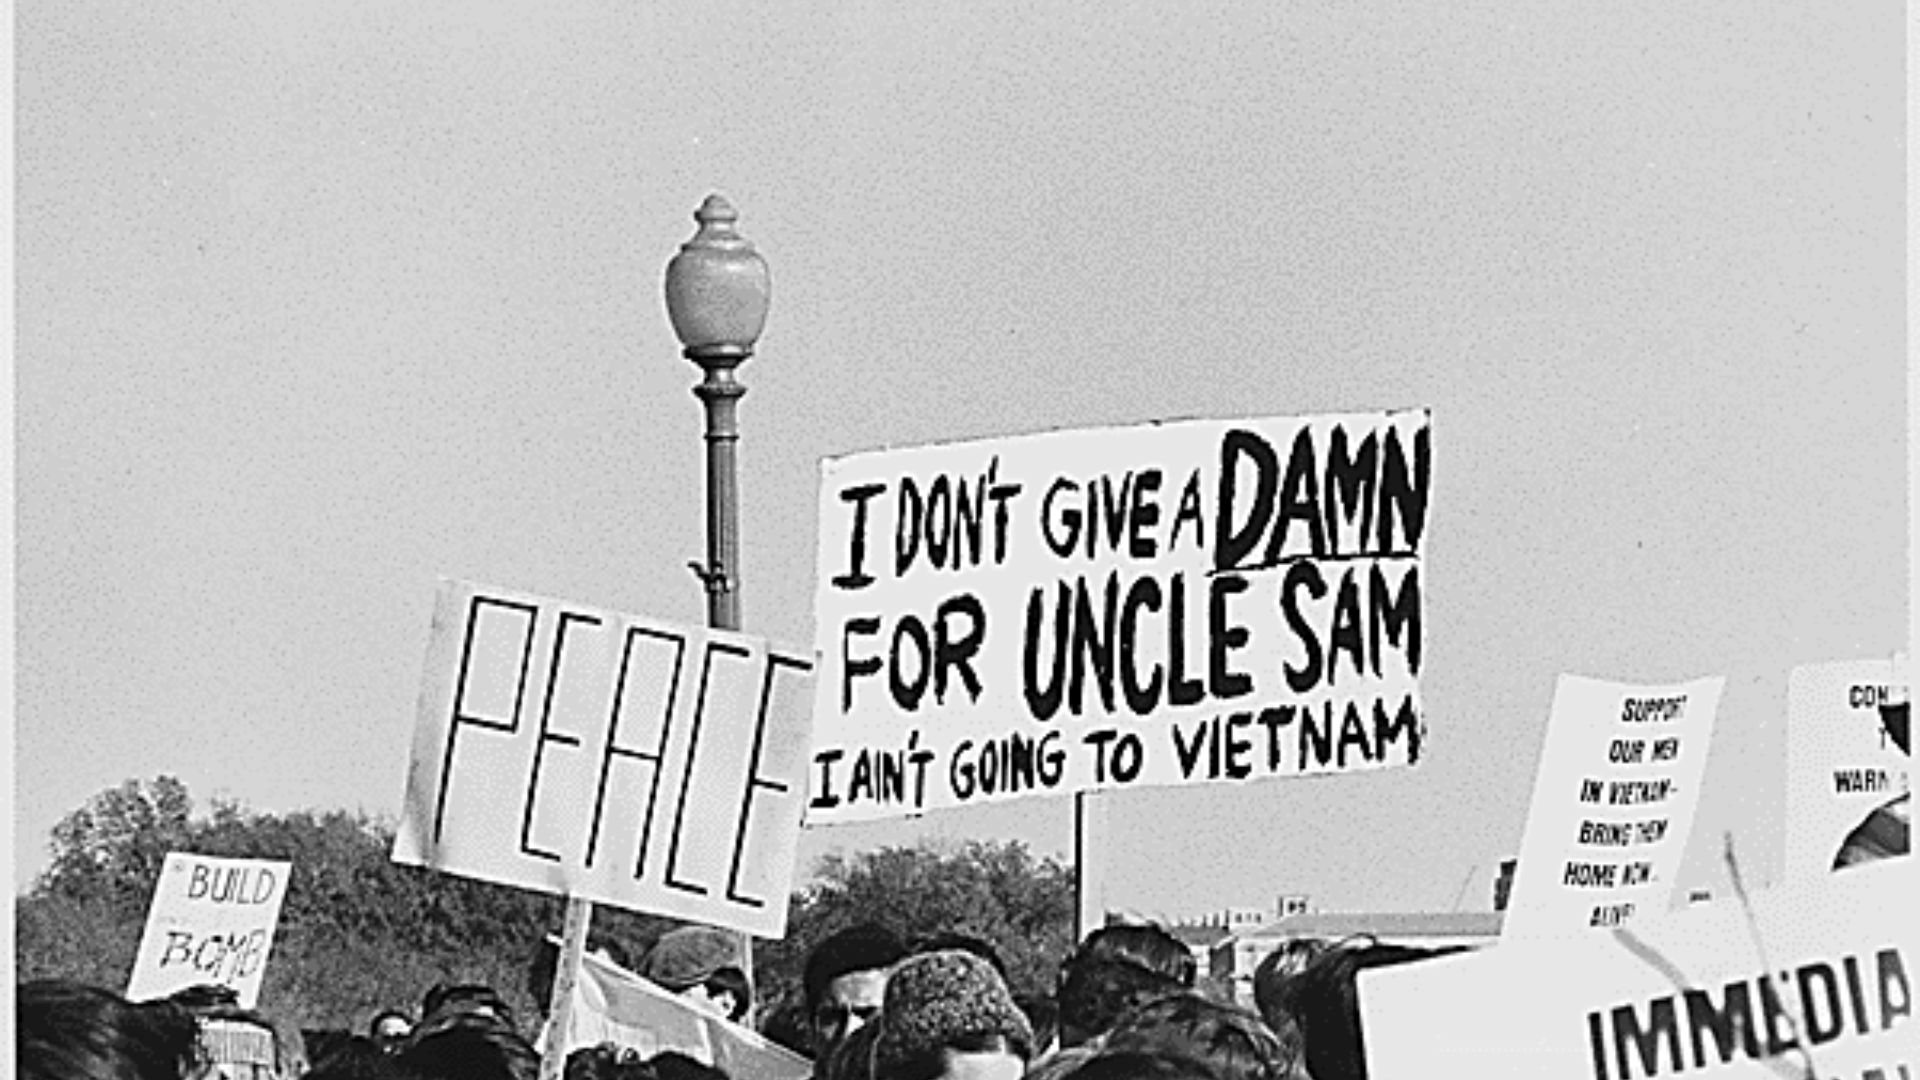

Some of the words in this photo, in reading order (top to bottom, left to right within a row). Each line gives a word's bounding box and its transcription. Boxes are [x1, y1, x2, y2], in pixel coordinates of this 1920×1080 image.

[832, 484, 886, 589] I
[896, 455, 1022, 576] DON'T
[1041, 470, 1162, 558] GIVE
[1170, 467, 1204, 551] A
[1215, 425, 1430, 570] DAMN
[843, 593, 986, 714] FOR
[1024, 570, 1253, 721] UNCLE
[1282, 560, 1422, 692] SAM
[434, 596, 813, 907] PEACE
[810, 750, 843, 807] I
[849, 729, 934, 807] AIN'T
[950, 731, 1066, 800] GOING
[1084, 731, 1143, 783] TO
[1173, 694, 1424, 781] VIETNAM
[1609, 739, 1645, 762] OUR
[1651, 738, 1679, 762] MEN
[1580, 778, 1604, 802] IN
[1578, 819, 1632, 846] BRING
[188, 864, 276, 904] BUILD
[1563, 861, 1617, 886] HOME
